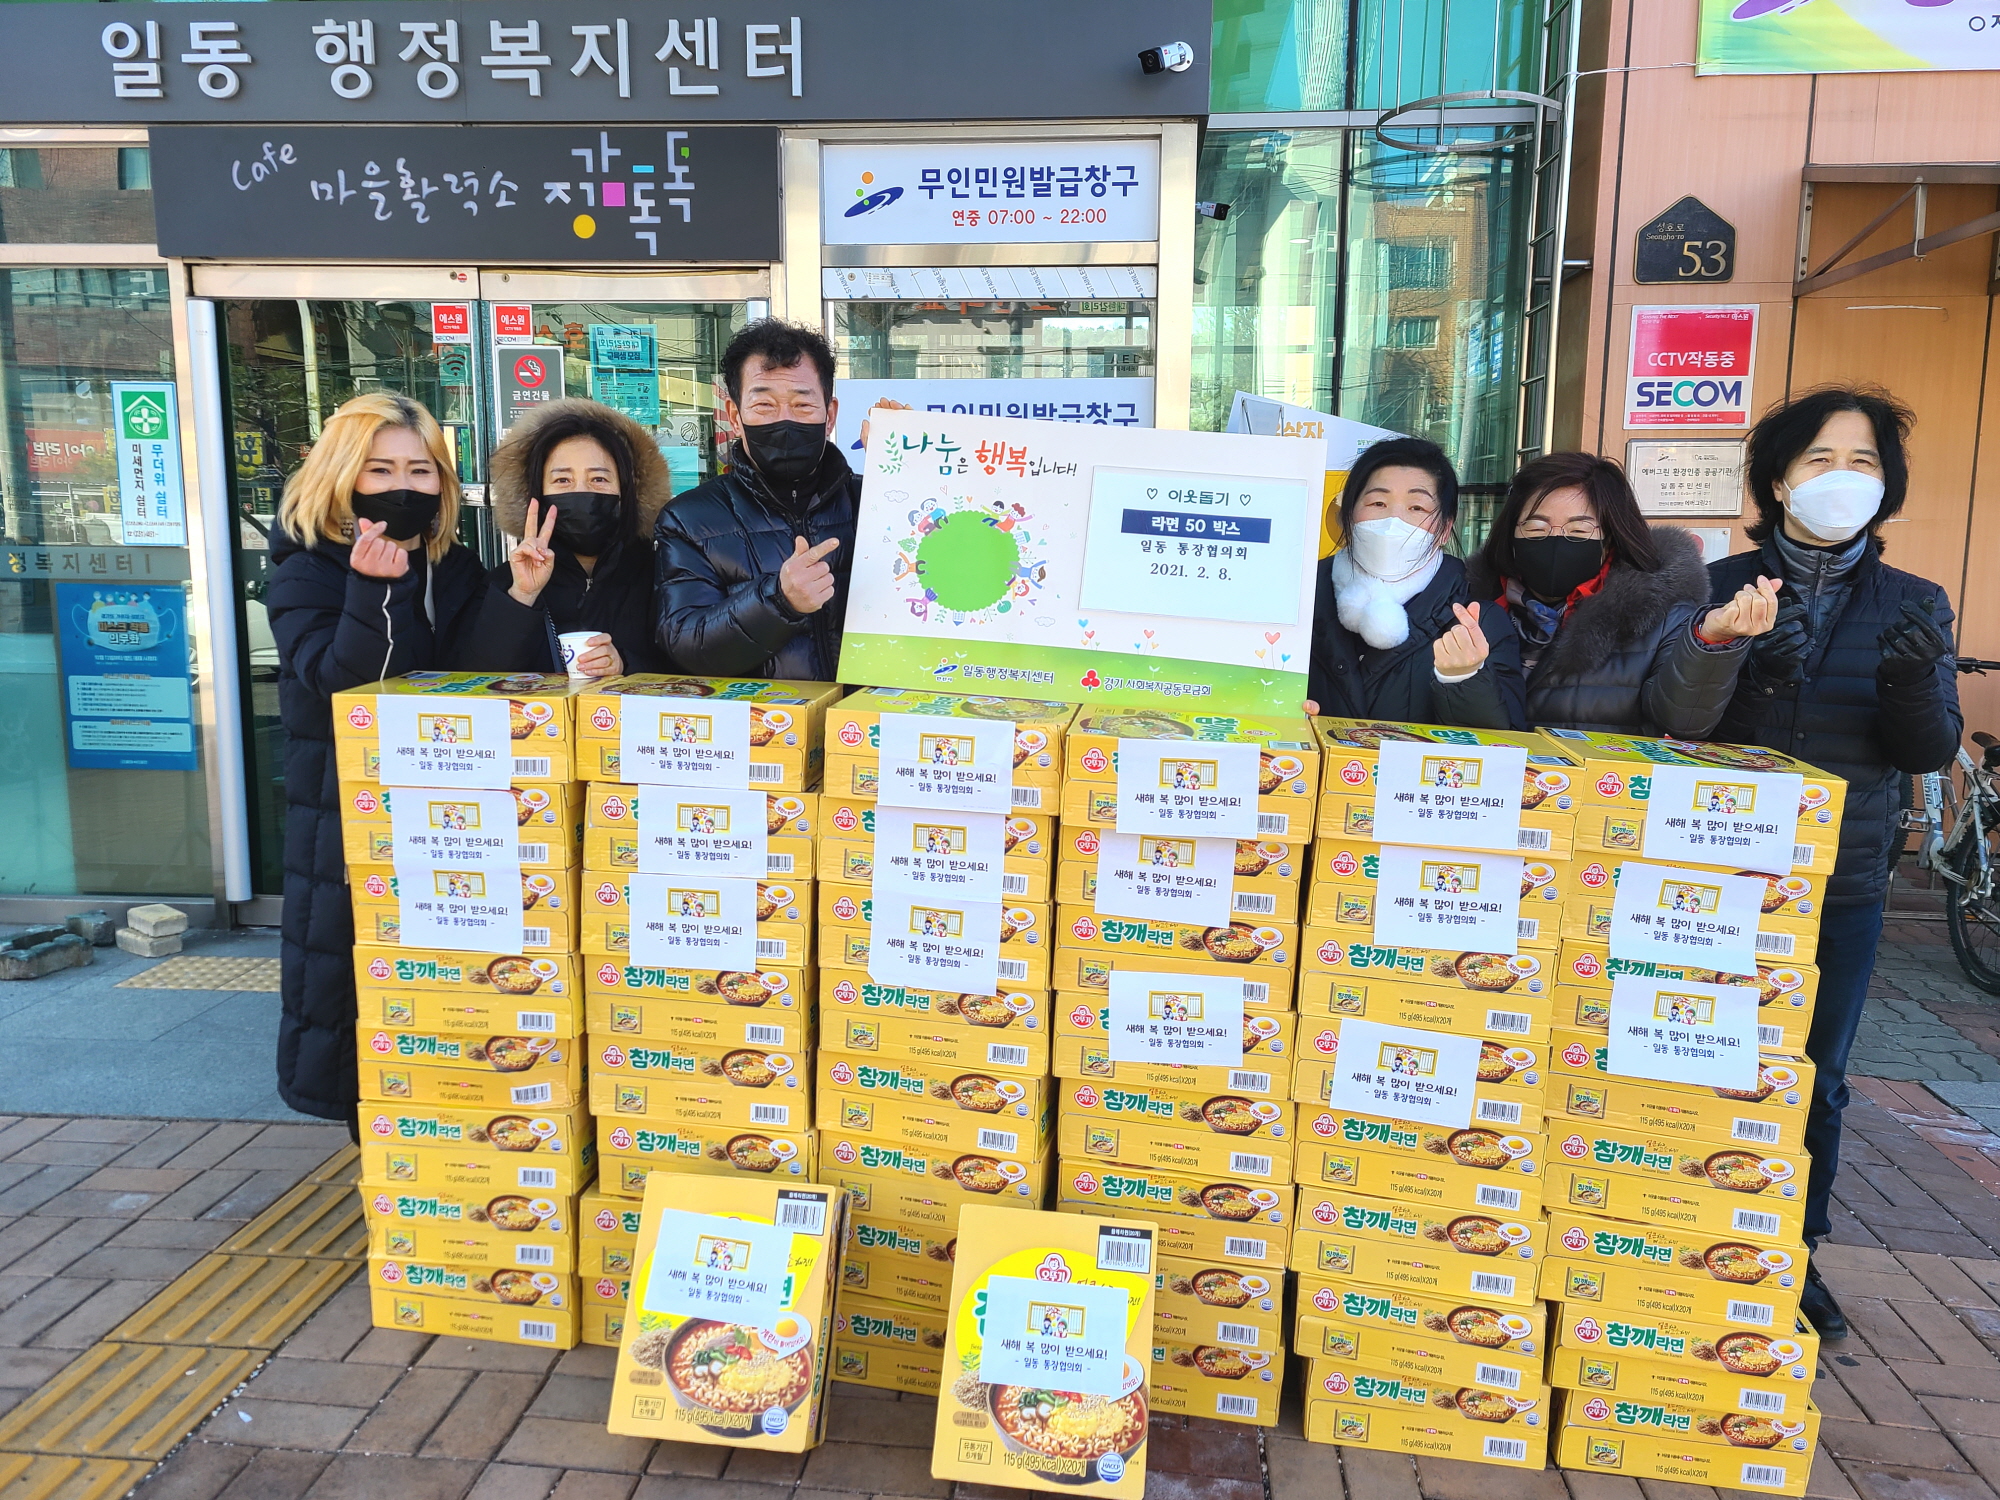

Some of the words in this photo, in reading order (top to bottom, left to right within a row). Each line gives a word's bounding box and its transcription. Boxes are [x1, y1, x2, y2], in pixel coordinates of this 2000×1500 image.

[101, 19, 254, 99] 일동
[312, 17, 803, 100] 행정복지센터
[232, 142, 297, 190] Cafe
[310, 157, 518, 223] 마을활력소
[918, 165, 1139, 199] 무인민원발급창구
[952, 210, 981, 227] 연중
[988, 209, 1035, 225] 07:00
[1060, 209, 1107, 224] 22:00
[1657, 222, 1685, 232] 성호로
[1646, 233, 1685, 241] Seongho-ro
[1678, 240, 1727, 277] 53
[439, 313, 463, 324] 에스원
[500, 315, 525, 325] 에스원
[1648, 351, 1735, 368] CCTV작동중
[512, 390, 550, 400] 금연건물
[1637, 380, 1742, 407] SECOM
[902, 431, 968, 476] 나눔은
[975, 440, 1077, 477] 행복입니다!
[132, 443, 145, 491] 미세먼지
[151, 444, 165, 486] 무더위
[1641, 468, 1670, 477] 에버그린
[1672, 468, 1701, 477] 환경인증
[1704, 468, 1733, 477] 공공기관
[155, 491, 168, 519] 쉼터
[1168, 489, 1230, 506] 이웃돕기
[136, 495, 147, 519] 쉼터
[1151, 516, 1179, 532] 라면
[1185, 519, 1206, 533] 50
[1213, 520, 1241, 536] 박스
[1140, 540, 1168, 554] 일동
[1177, 542, 1248, 560] 통장협의회
[1150, 563, 1188, 577] 2021.
[1197, 566, 1210, 579] 2.
[1218, 568, 1232, 581] 8.
[963, 664, 1055, 684] 일동행정복지센터
[1104, 676, 1123, 690] 경기
[1125, 679, 1212, 696] 사회복지공동모금회
[842, 732, 862, 744] 오뚜기
[397, 747, 414, 756] 새해
[420, 747, 429, 757] 복
[433, 748, 451, 758] 많이
[456, 749, 495, 759] 받으세요!
[419, 761, 433, 770] 일동
[438, 762, 473, 771] 통장협의회
[1085, 758, 1106, 769] 오뚜기
[896, 767, 914, 777] 새해
[919, 769, 928, 779] 복
[933, 770, 951, 780] 많이
[956, 772, 996, 783] 받으세요!
[1344, 769, 1366, 780] 오뚜기
[919, 782, 932, 792] 일동
[937, 784, 973, 794] 통장협의회
[1600, 782, 1620, 794] 오뚜기
[1135, 794, 1154, 803] 새해
[1160, 794, 1169, 805] 복
[1174, 795, 1193, 805] 많이
[1199, 796, 1241, 807] 받으세요!
[1394, 793, 1414, 803] 새해
[1420, 794, 1429, 804] 복
[1435, 795, 1454, 805] 많이
[1460, 796, 1503, 808] 받으세요!
[1159, 809, 1174, 818] 일동
[1178, 809, 1216, 819] 통장협의회
[1418, 808, 1433, 818] 일동
[1438, 809, 1478, 820] 통장협의회
[1665, 818, 1686, 828] 새해
[1691, 819, 1701, 830] 복
[1707, 820, 1727, 831] 많이
[1733, 822, 1778, 834] 받으세요!
[655, 837, 672, 846] 새해
[677, 838, 686, 847] 복
[691, 838, 708, 848] 많이
[713, 840, 752, 849] 받으세요!
[1690, 834, 1705, 844] 일동
[1710, 835, 1750, 846] 통장협의회
[677, 851, 690, 859] 일동
[695, 851, 730, 861] 통장협의회
[396, 960, 460, 980] 참깨라면
[630, 1049, 694, 1070] 참깨라면
[858, 1067, 923, 1093] 참깨라면
[1104, 1090, 1173, 1115] 참깨라면
[1640, 1116, 1648, 1125] 115
[637, 1131, 699, 1154] 참깨라면
[861, 1146, 925, 1173] 참깨라면
[1593, 1140, 1672, 1169] 참깨라면
[398, 1197, 460, 1217] 참깨라면
[1343, 1207, 1417, 1234] 참깨라면
[1594, 1232, 1672, 1261] 참깨라면
[668, 1269, 687, 1280] 새해
[692, 1272, 700, 1284] 복
[706, 1275, 723, 1287] 많이
[728, 1278, 767, 1293] 받으세요!
[1041, 1269, 1066, 1282] 오뚜기
[689, 1287, 702, 1298] 일동
[1343, 1293, 1417, 1323] 참깨라면
[761, 1328, 779, 1347] 계란이
[1606, 1323, 1684, 1353] 참깨라면
[1001, 1339, 1021, 1350] 새해
[1026, 1341, 1035, 1353] 복
[1041, 1343, 1059, 1355] 많이
[1065, 1345, 1107, 1360] 받으세요!
[1024, 1358, 1039, 1369] 일동
[675, 1409, 685, 1421] 115
[963, 1442, 989, 1453] 유통기간
[1003, 1453, 1016, 1467] 115
